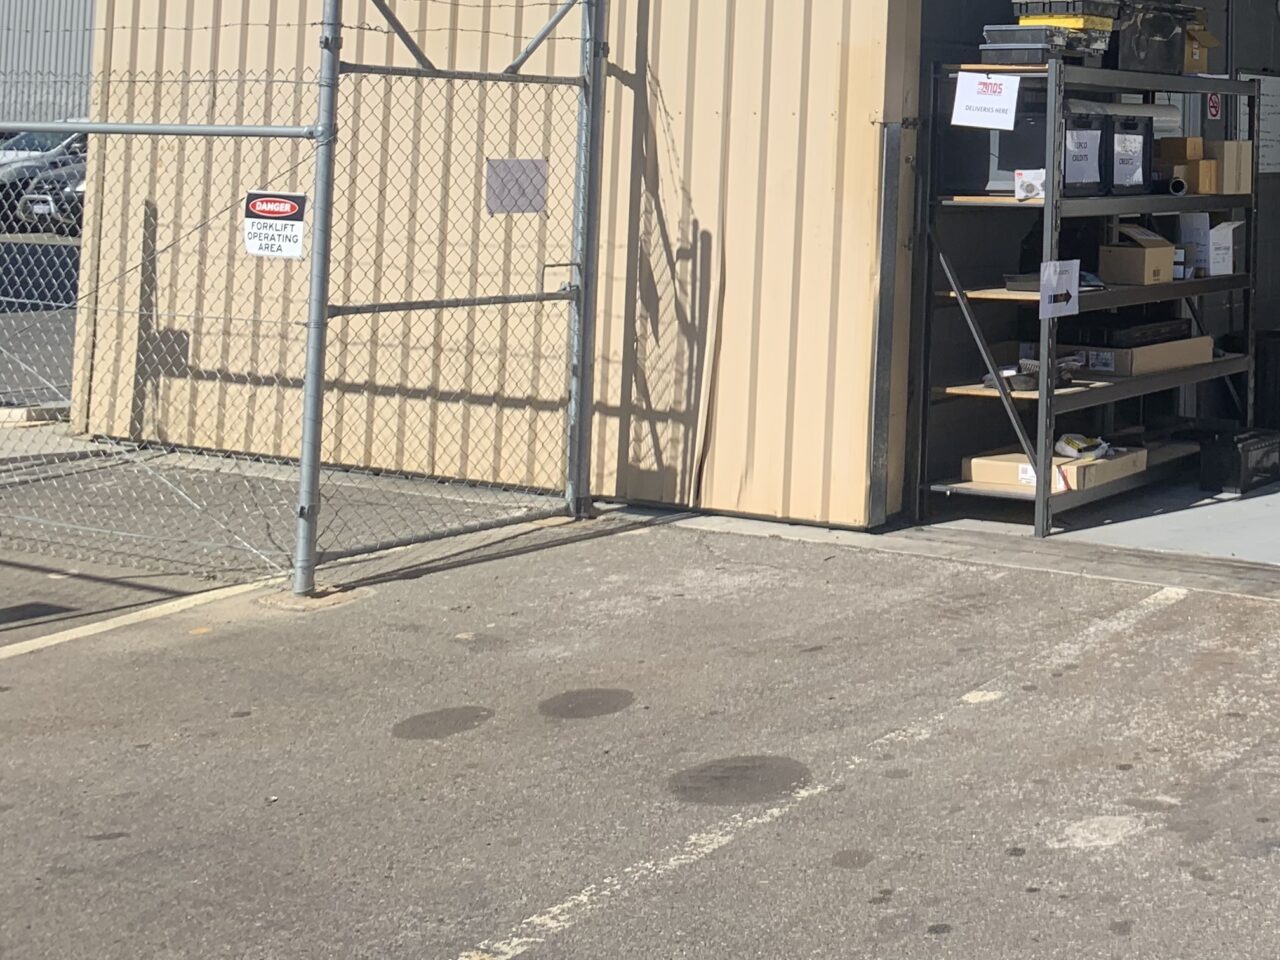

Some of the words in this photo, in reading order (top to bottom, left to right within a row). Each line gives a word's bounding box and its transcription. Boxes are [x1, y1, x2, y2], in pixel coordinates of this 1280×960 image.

[965, 105, 994, 113] DELIVERIES
[995, 107, 1009, 115] HERE
[255, 201, 292, 213] DANGER
[251, 221, 296, 233] FORKLIFT
[247, 231, 299, 244] OPERATING
[258, 242, 283, 253] AREA
